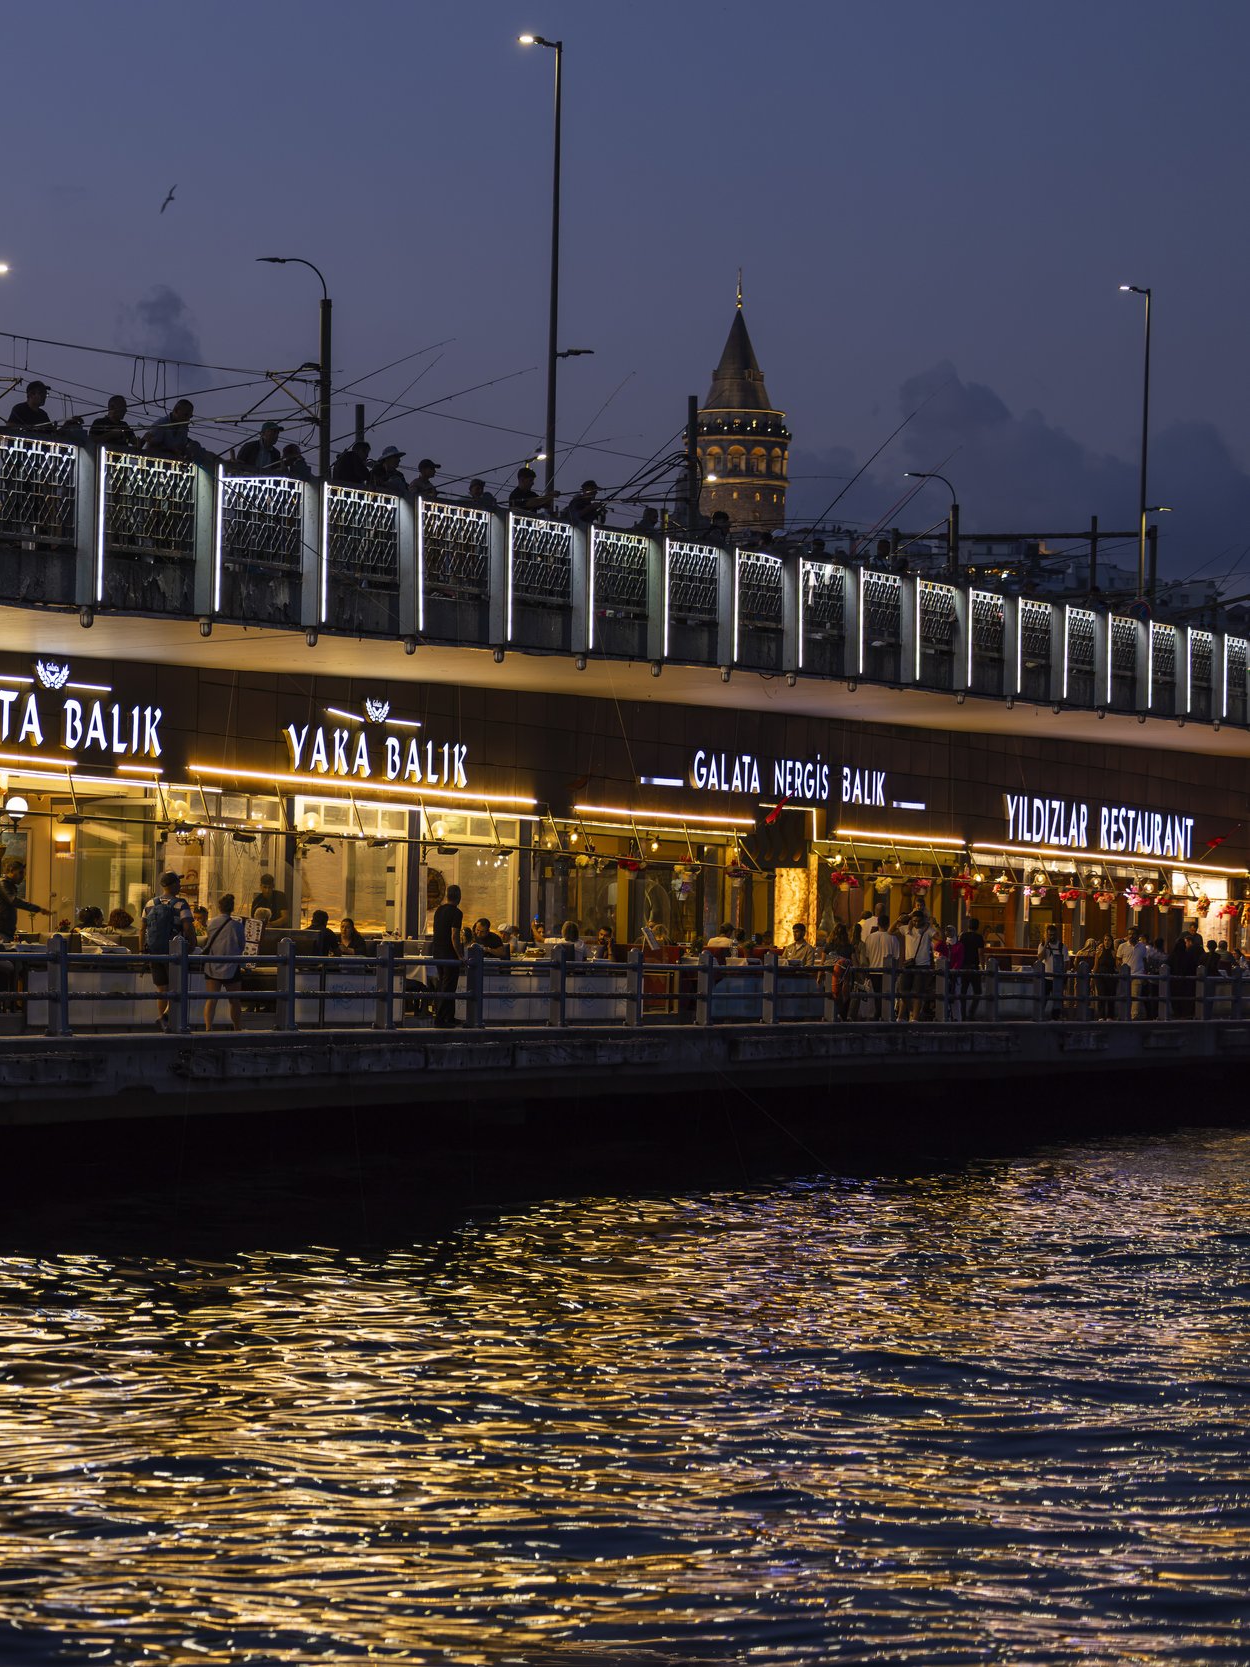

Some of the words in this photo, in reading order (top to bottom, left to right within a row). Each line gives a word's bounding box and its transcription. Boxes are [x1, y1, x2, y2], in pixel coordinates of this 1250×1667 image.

[63, 698, 163, 757] BALIK
[287, 723, 372, 778] YAKA
[385, 736, 468, 788] BALIK
[693, 750, 761, 793] GALATA
[774, 754, 829, 800] NERGİS
[842, 766, 886, 807] BALIK
[1005, 794, 1088, 848] YILDIZLAR
[1100, 806, 1194, 861] RESTAURANT
